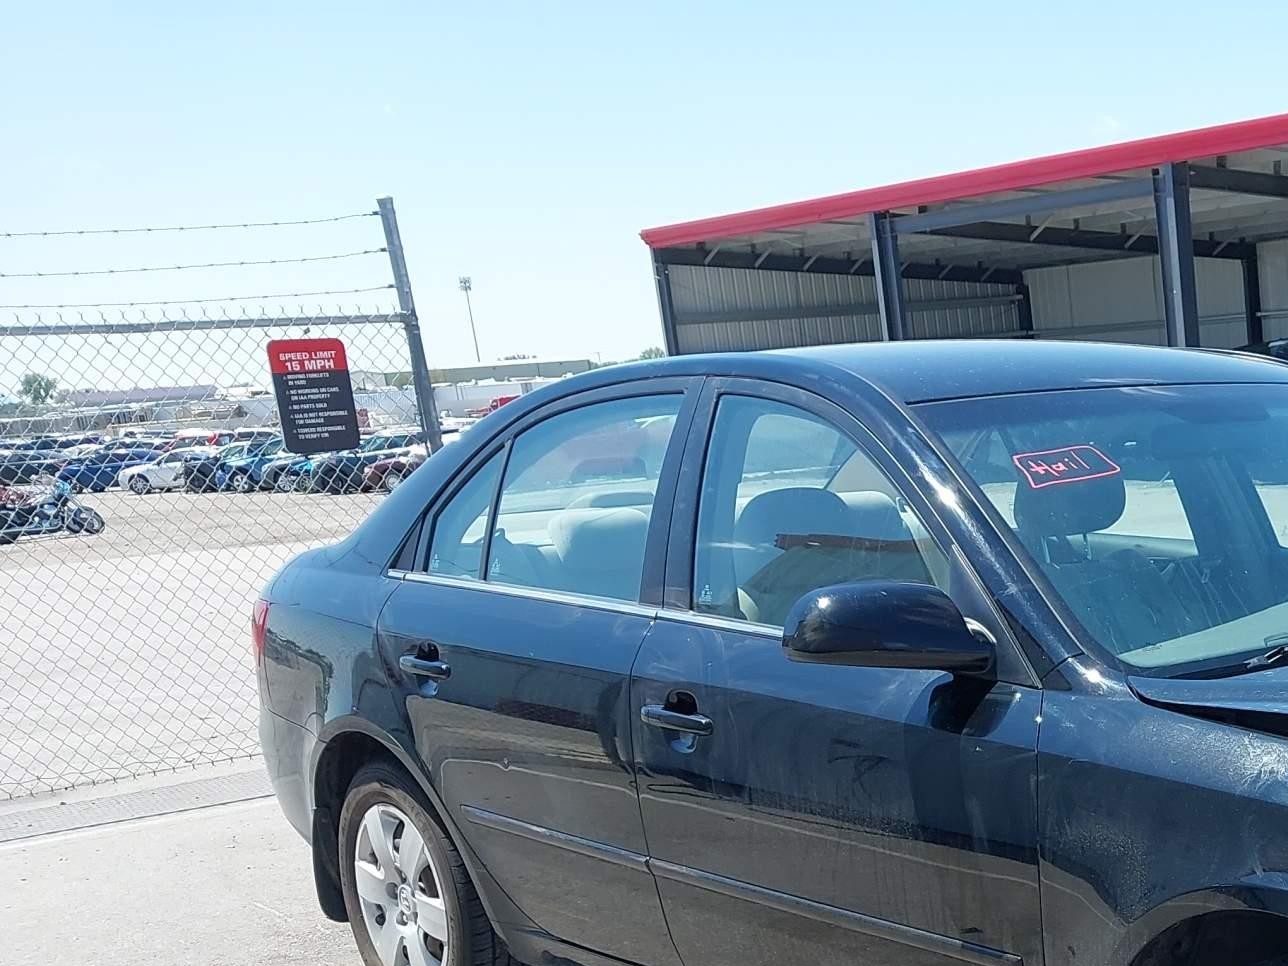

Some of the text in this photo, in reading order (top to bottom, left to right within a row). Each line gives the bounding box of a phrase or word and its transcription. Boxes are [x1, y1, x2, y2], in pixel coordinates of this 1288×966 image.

[285, 359, 335, 371] 15 MPH
[1027, 450, 1090, 477] Hail
